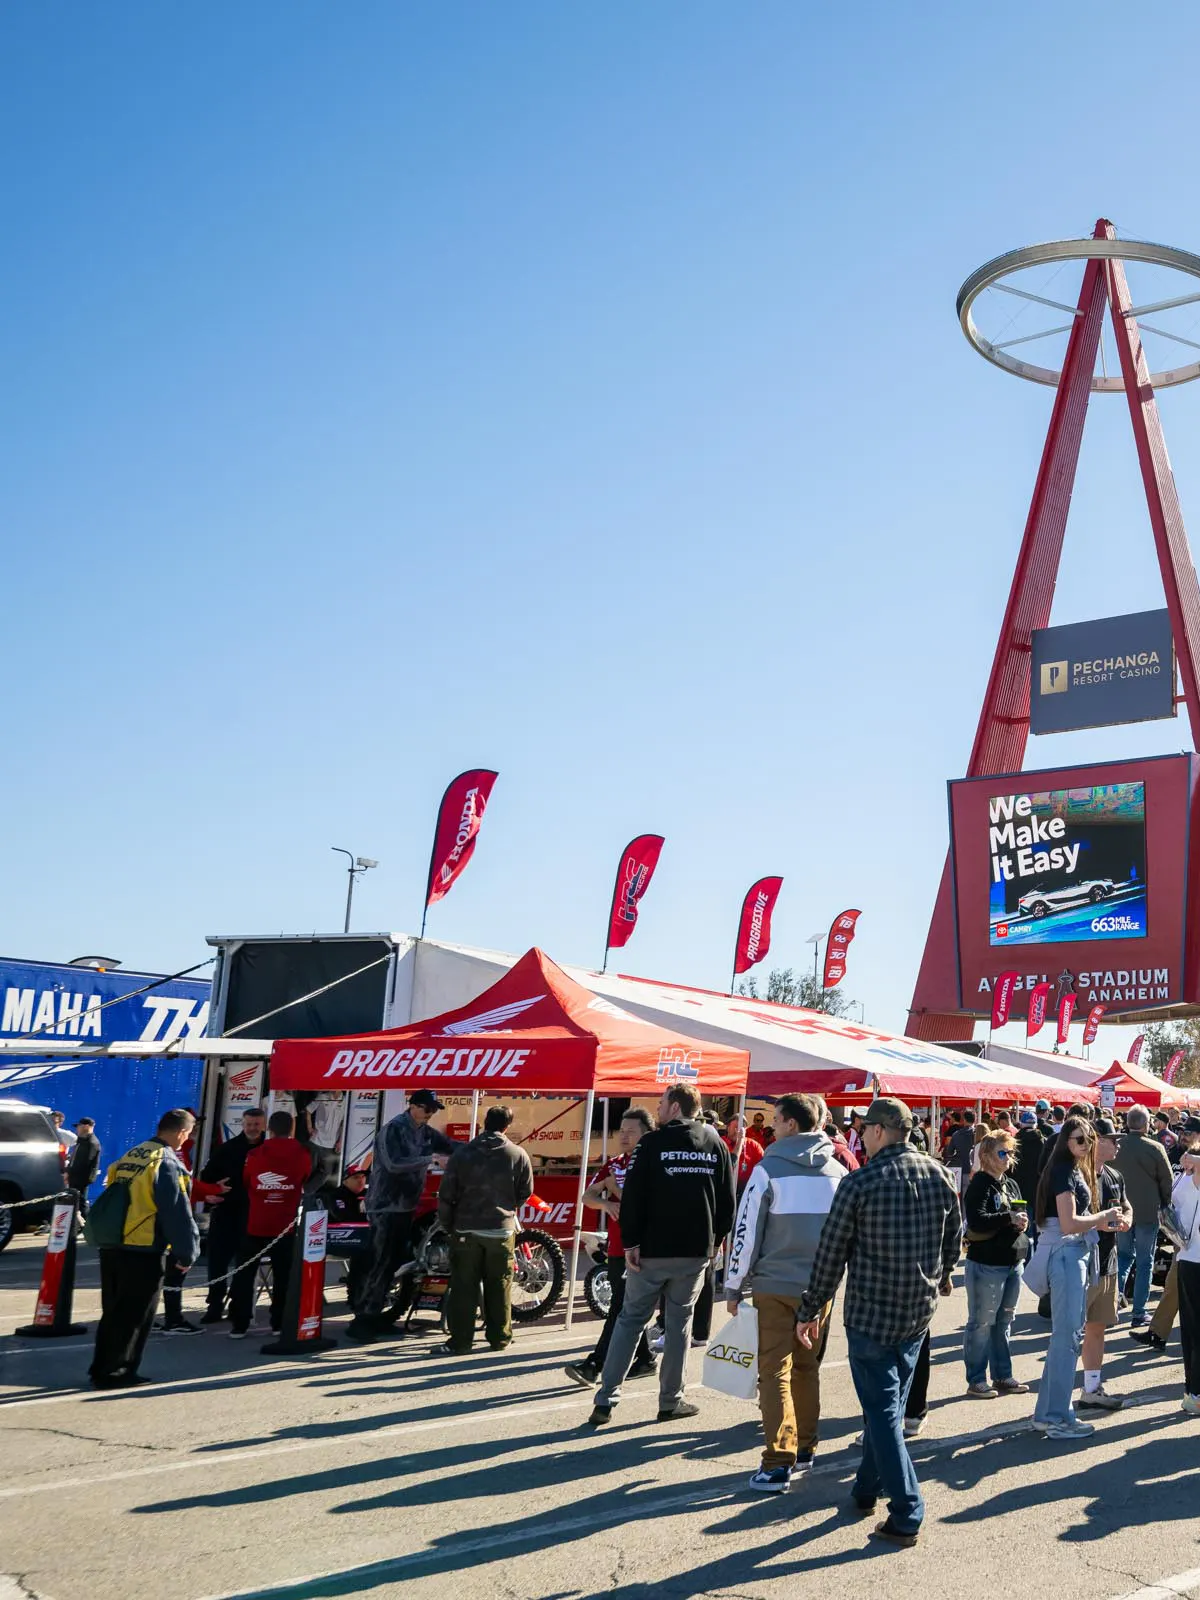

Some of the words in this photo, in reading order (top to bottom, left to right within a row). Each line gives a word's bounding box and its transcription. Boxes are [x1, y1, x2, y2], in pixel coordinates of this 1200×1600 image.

[1073, 651, 1160, 676] PECHANGA
[1073, 672, 1114, 686] RESORT
[1119, 665, 1161, 679] CASINO
[989, 795, 1032, 824] We
[449, 787, 479, 861] HONDA
[989, 815, 1066, 853] Make
[992, 855, 1014, 882] It
[1017, 842, 1080, 877] Easy
[747, 891, 769, 961] PROGRESSIVE
[1009, 925, 1032, 934] CAMRY
[1091, 917, 1116, 932] 663
[1115, 916, 1131, 924] MILE
[1115, 922, 1140, 931] RANGE
[978, 974, 1054, 993] AGEL
[1078, 968, 1169, 988] STADIUM
[1000, 978, 1011, 1012] HONDA
[1088, 987, 1169, 1002] ANAHEIM
[323, 1048, 531, 1078] PROGRESSIVE
[656, 1047, 702, 1079] HRC
[540, 1130, 564, 1141] SHOWA
[660, 1151, 718, 1163] PETRONAS
[706, 1344, 754, 1368] ARC
